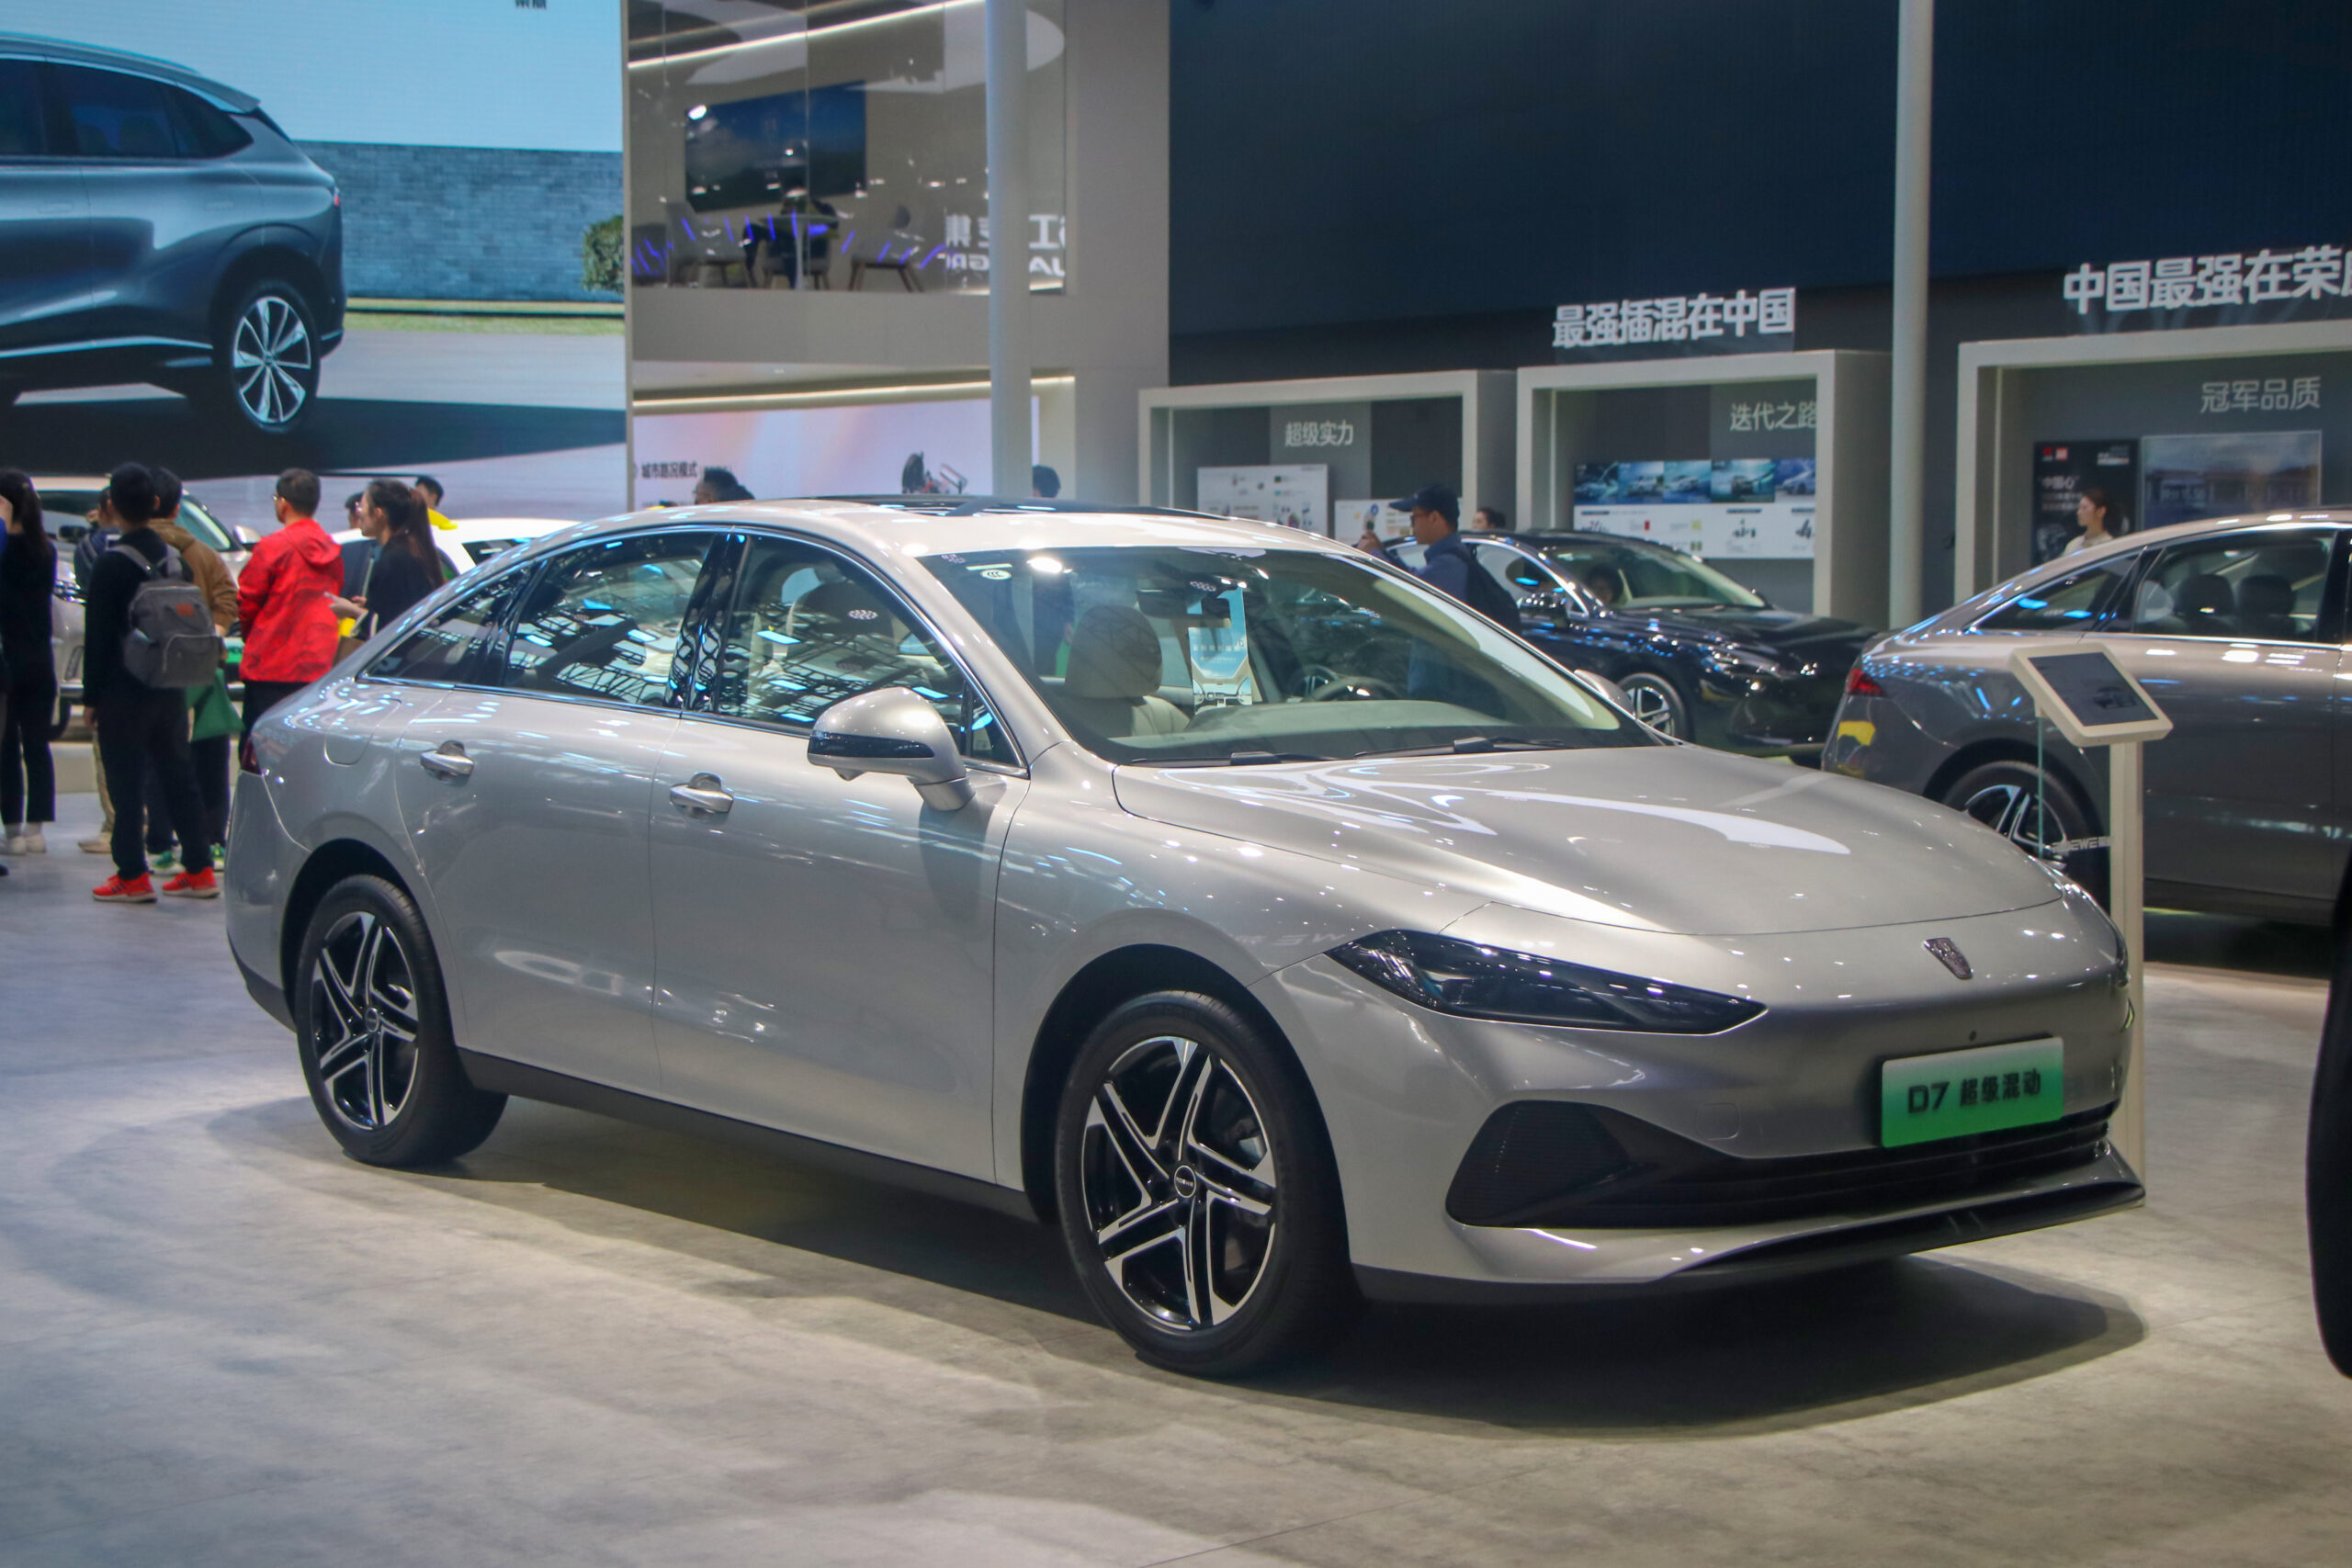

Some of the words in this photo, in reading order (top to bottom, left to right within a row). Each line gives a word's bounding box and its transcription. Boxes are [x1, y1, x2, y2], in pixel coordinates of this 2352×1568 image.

[2064, 244, 2352, 314] 中国最强在荣
[1552, 287, 1795, 348] 最强插混在中国
[2200, 377, 2321, 413] 冠军品质
[1285, 419, 1354, 447] 超级实力
[1729, 401, 1816, 431] 迭代之路
[1907, 1081, 1950, 1113] D7
[1959, 1068, 2041, 1108] 超级混动
